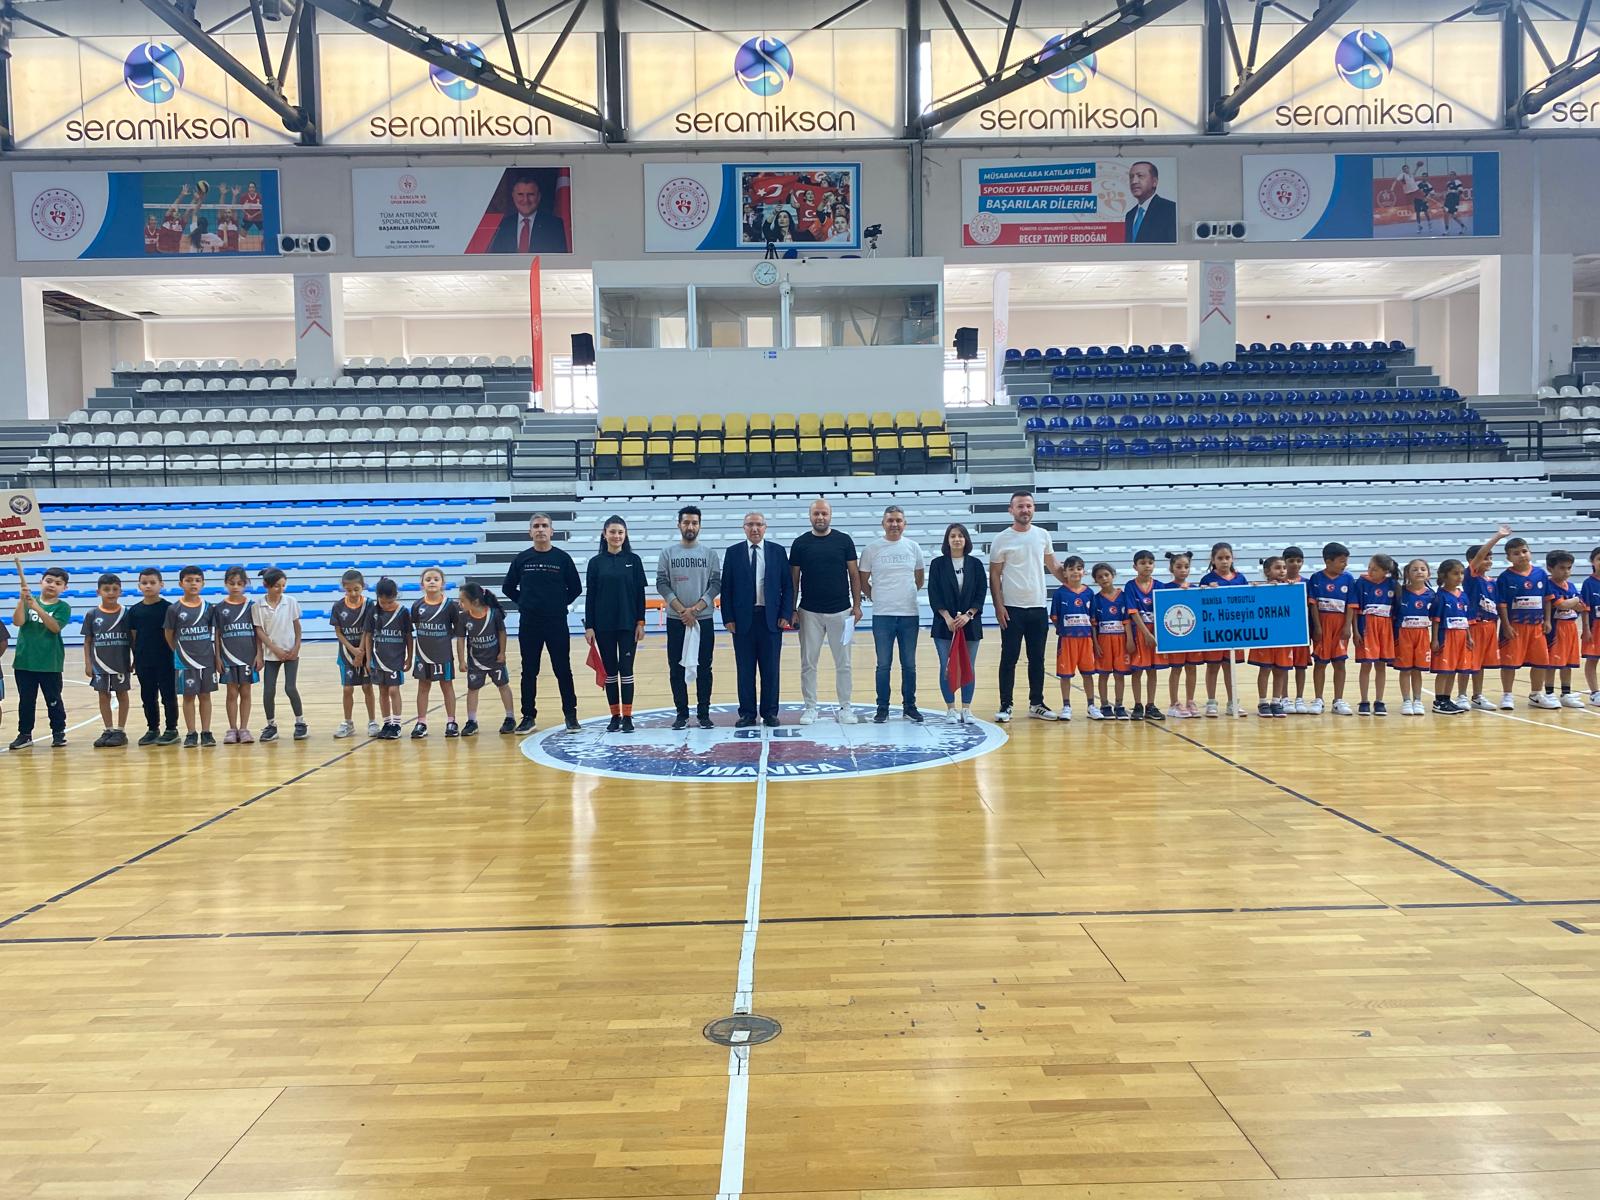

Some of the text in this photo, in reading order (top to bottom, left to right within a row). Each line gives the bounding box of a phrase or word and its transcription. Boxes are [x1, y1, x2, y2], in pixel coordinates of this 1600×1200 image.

[675, 105, 856, 133] seramiksan
[980, 102, 1158, 131] seramiksan
[1275, 98, 1453, 126] seramiksan
[1552, 101, 1600, 123] ser
[65, 113, 250, 142] seramiksan
[370, 110, 552, 137] seramiksan
[984, 170, 1043, 180] MÜSABAKALARA
[1075, 166, 1091, 174] TÜM
[983, 186, 1015, 194] SPORCU
[1027, 184, 1089, 193] ANTRENÖRLERE
[986, 197, 1097, 211] BAŞARILAR DİLERİM.
[1019, 231, 1107, 243] RECEP TAYYİP ERDOĞAN
[670, 557, 707, 568] HOODRICH
[1202, 610, 1215, 622] Dr.
[1218, 608, 1255, 624] Hüseyin
[1258, 605, 1290, 618] ORHAN
[1203, 627, 1269, 643] İLKOKULU
[244, 665, 252, 676] 5
[390, 671, 397, 679] 3
[434, 664, 443, 674] 11
[496, 670, 502, 680] 7
[118, 673, 125, 684] 9
[698, 763, 846, 776] MANİSA
